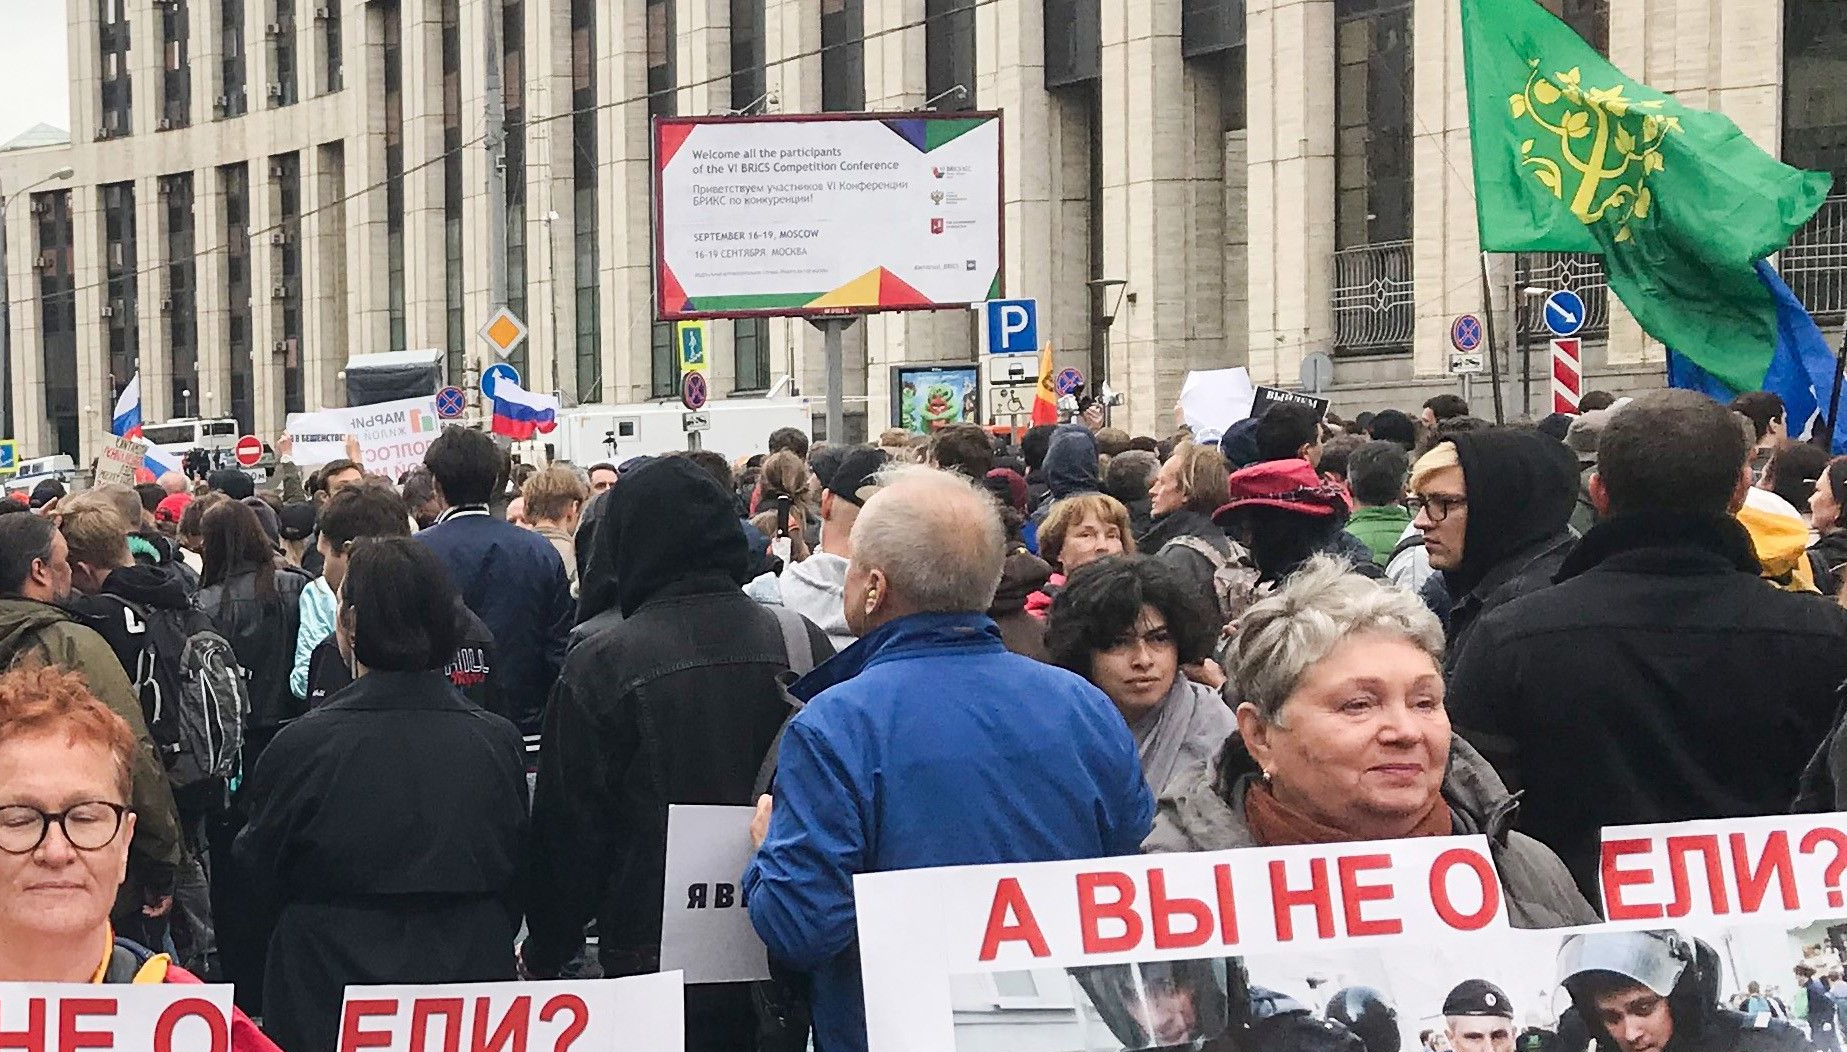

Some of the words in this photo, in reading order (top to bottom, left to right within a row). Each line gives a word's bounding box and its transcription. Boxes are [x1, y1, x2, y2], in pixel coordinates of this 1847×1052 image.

[692, 149, 740, 160] Welcome
[744, 149, 756, 159] all
[759, 148, 776, 158] the
[779, 148, 842, 160] participants
[692, 164, 704, 174] of
[707, 164, 724, 174] the
[728, 163, 737, 173] VI
[773, 162, 837, 175] Competition
[840, 160, 899, 171] Conference
[693, 184, 764, 196] Приветствуем
[767, 183, 823, 195] участников
[827, 182, 836, 191] VI
[839, 181, 909, 193] Конференции
[693, 196, 726, 206] БРИКС
[729, 197, 742, 205] по
[744, 193, 814, 206] конкуренции!
[694, 231, 745, 242] SEPTEMBER
[748, 230, 777, 241] 16-19,
[779, 229, 819, 239] MOSCOW
[695, 249, 719, 259] 16-19
[721, 248, 766, 259] СЕНТЯБРЯ
[771, 246, 808, 257] МОСКВА
[1002, 305, 1028, 348] P
[1602, 826, 1847, 921] ЕЛИ?
[980, 878, 1050, 960] А
[1077, 864, 1239, 953] ВЫ
[1270, 855, 1402, 941] НЕ
